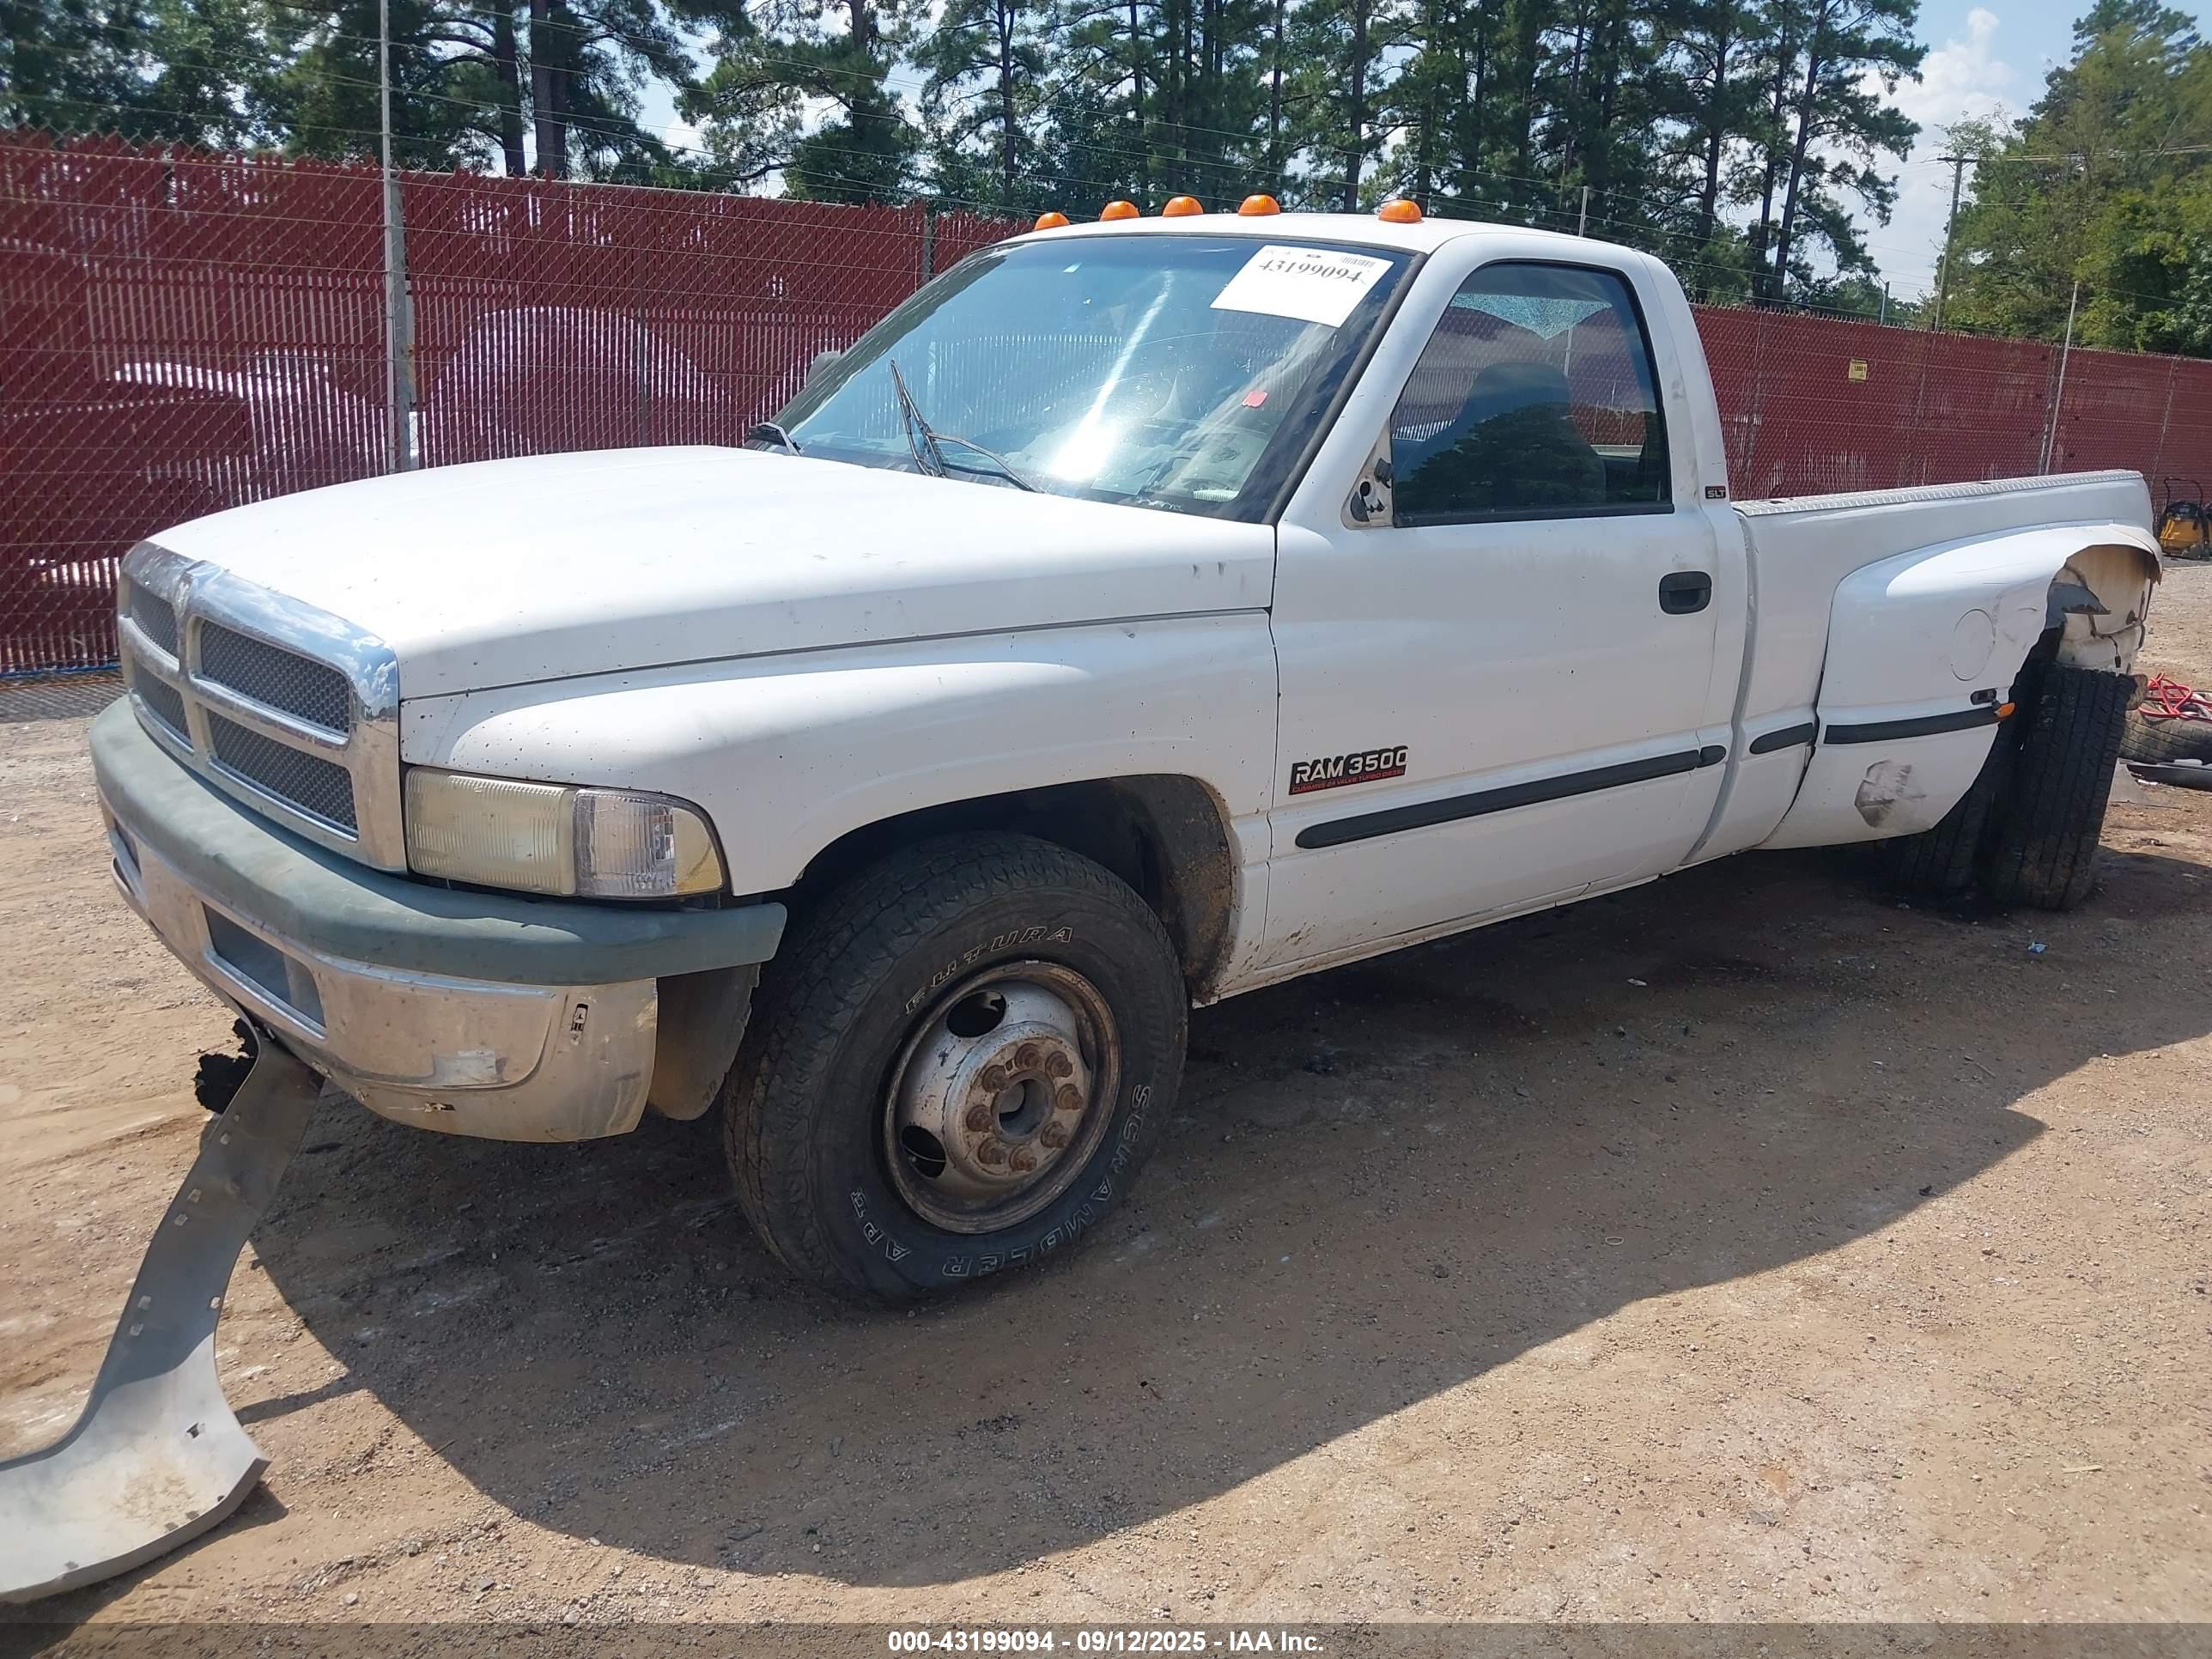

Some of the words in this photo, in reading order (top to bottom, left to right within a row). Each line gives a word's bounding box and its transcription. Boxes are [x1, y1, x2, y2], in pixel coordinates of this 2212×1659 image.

[1259, 258, 1364, 283] 43199094
[1707, 489, 1725, 498] SLT
[1295, 760, 1345, 784] RAM
[1348, 748, 1409, 775] 3500
[904, 926, 1073, 1015] FUTURA
[941, 1084, 1152, 1278] SCRAMBLER
